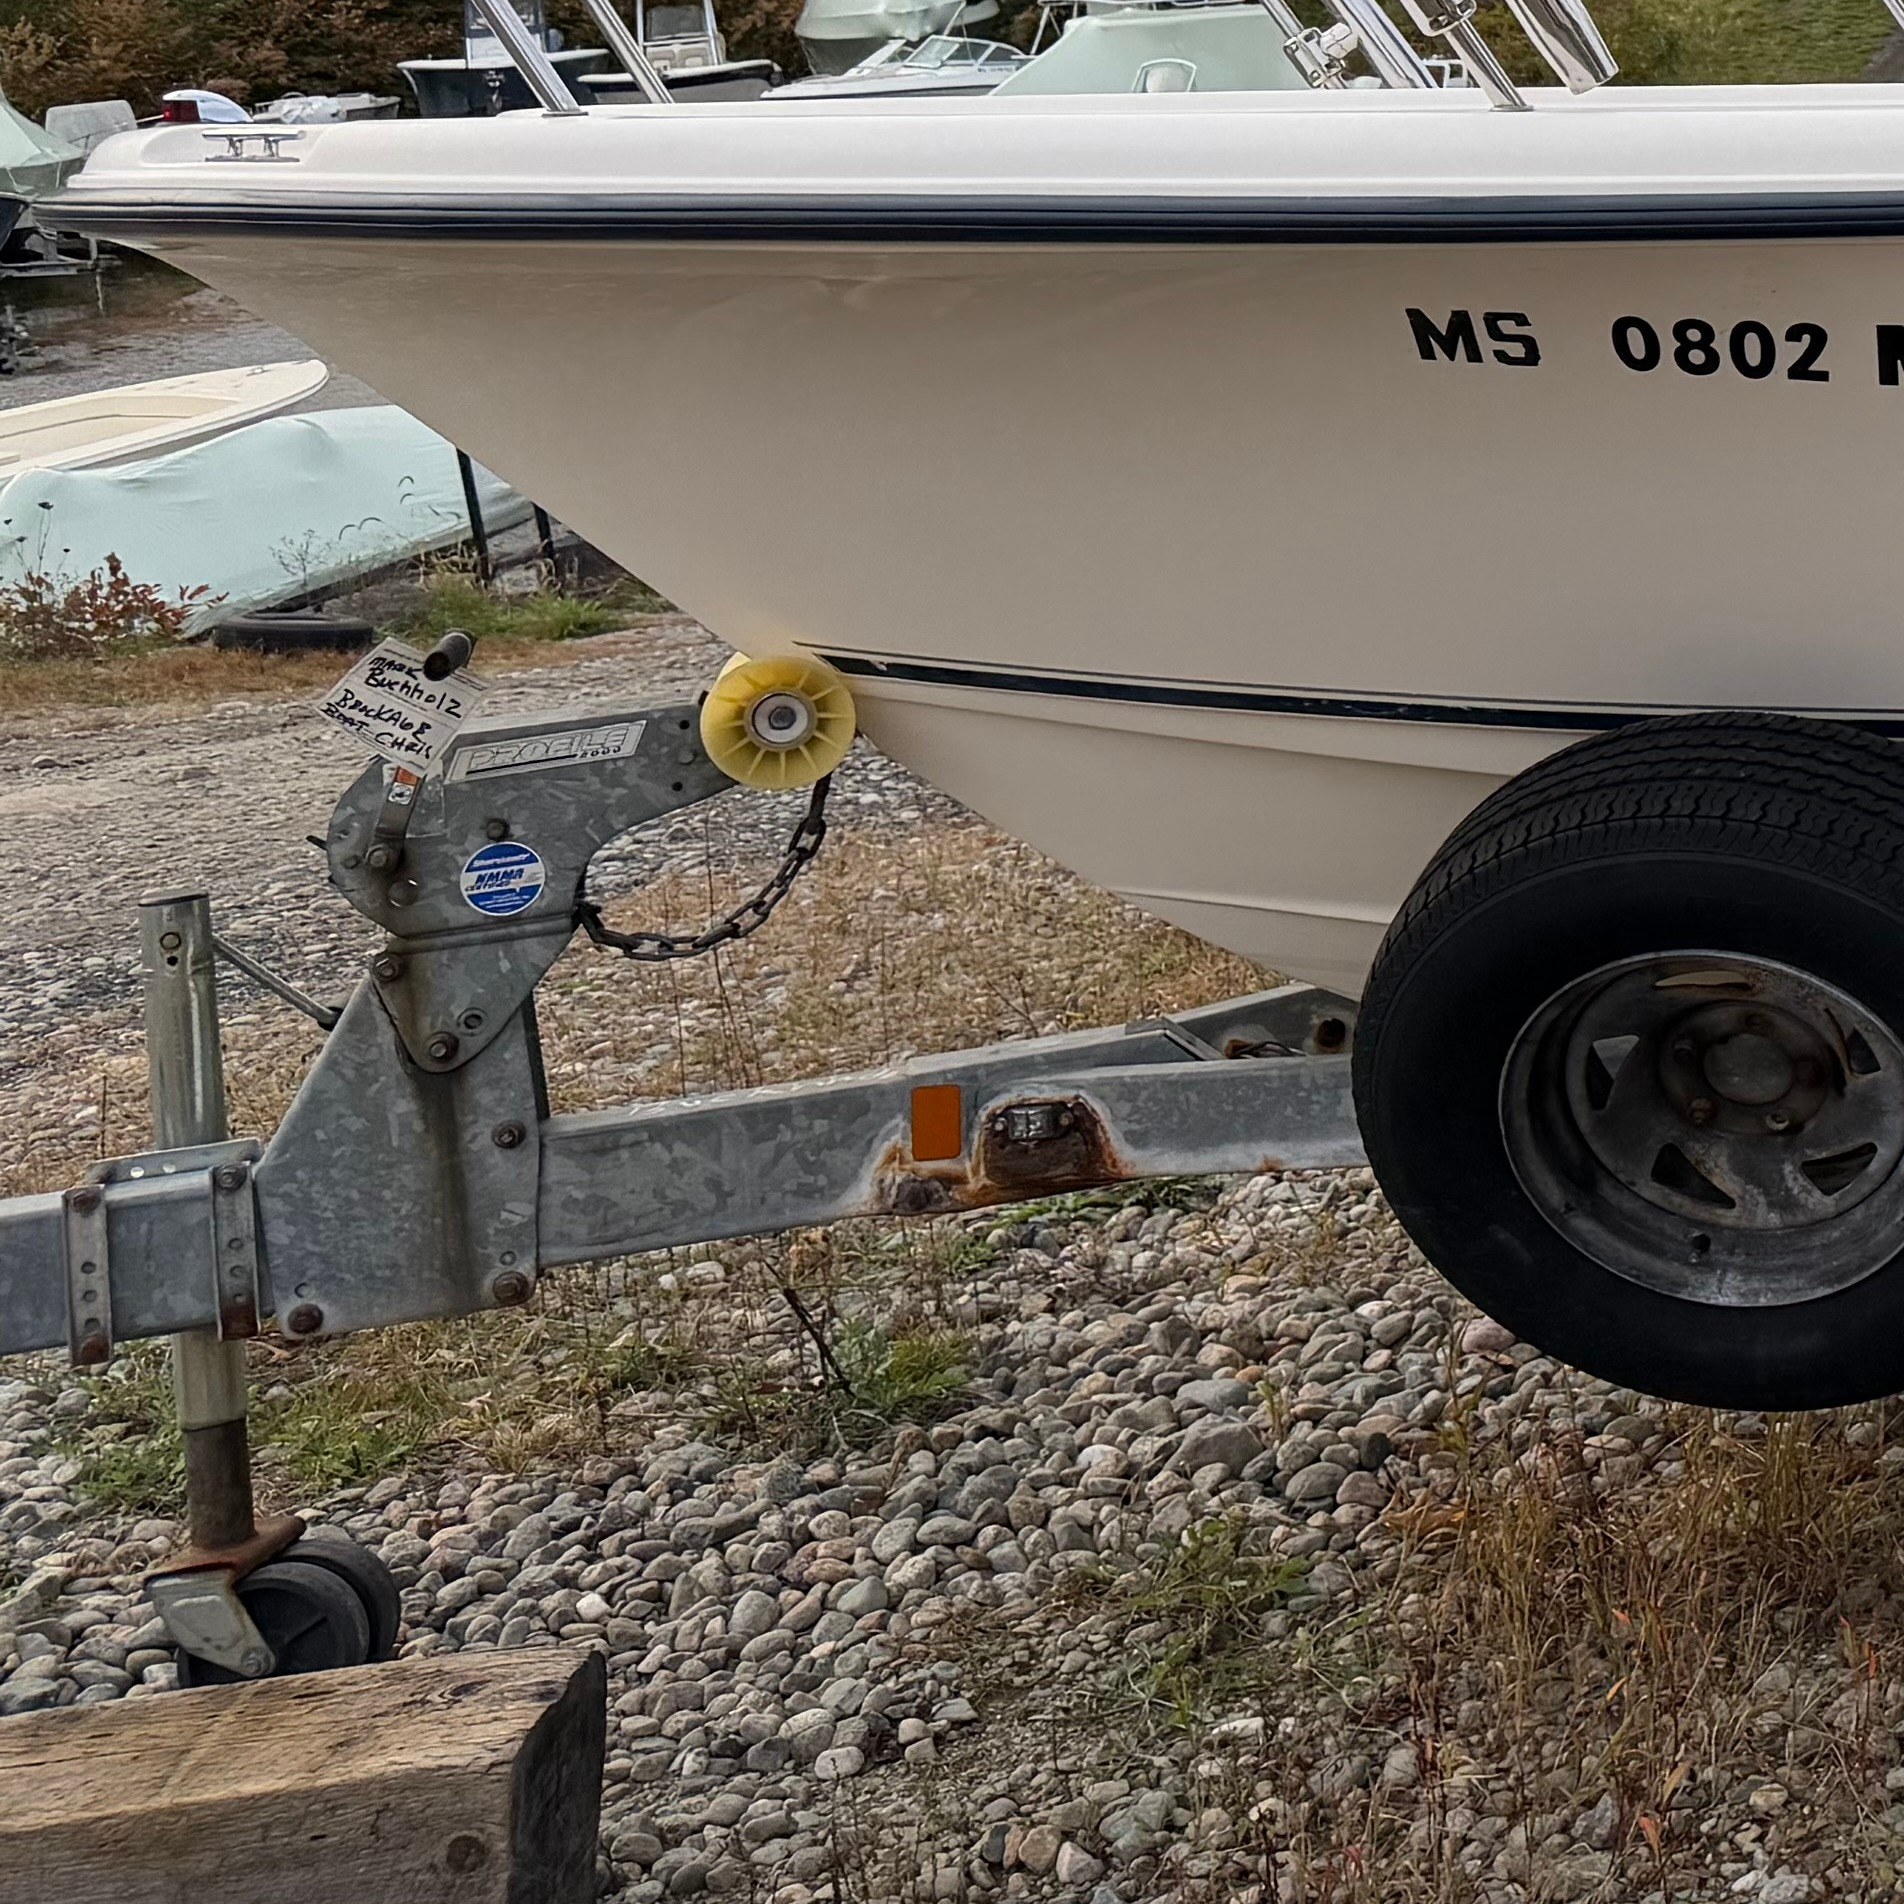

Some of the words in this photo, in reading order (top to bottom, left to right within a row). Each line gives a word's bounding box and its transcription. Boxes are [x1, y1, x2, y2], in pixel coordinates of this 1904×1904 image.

[1405, 307, 1542, 367] MS
[1610, 315, 1831, 383] 0802
[469, 726, 630, 770] PROFILE
